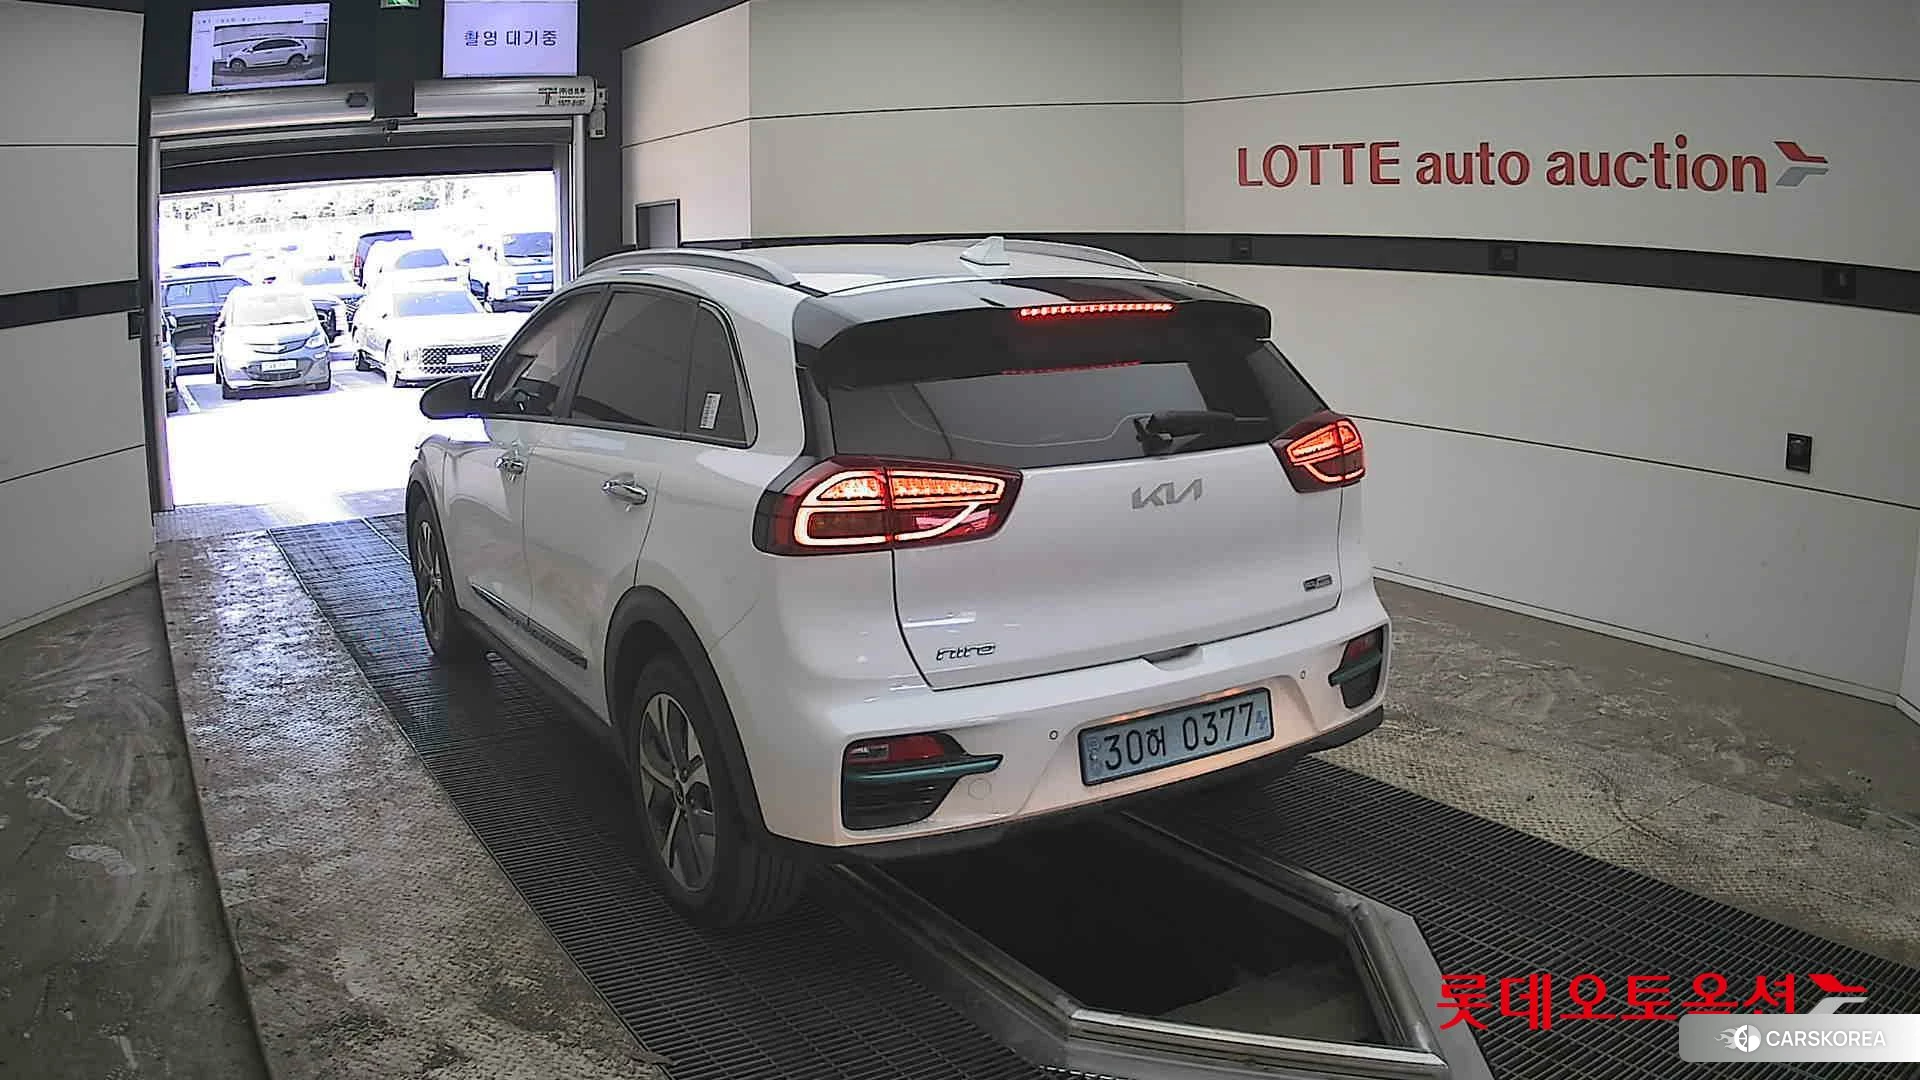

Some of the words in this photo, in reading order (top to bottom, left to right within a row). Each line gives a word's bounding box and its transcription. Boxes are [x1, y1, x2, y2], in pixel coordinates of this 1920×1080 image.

[464, 30, 497, 47] 촬영
[506, 30, 557, 47] 대기중
[1237, 140, 1400, 188] LOTTE
[1415, 141, 1530, 186] auto
[1545, 134, 1768, 194] auction
[1131, 478, 1203, 510] KIA
[1103, 725, 1167, 771] 30허
[1182, 702, 1254, 751] 0377
